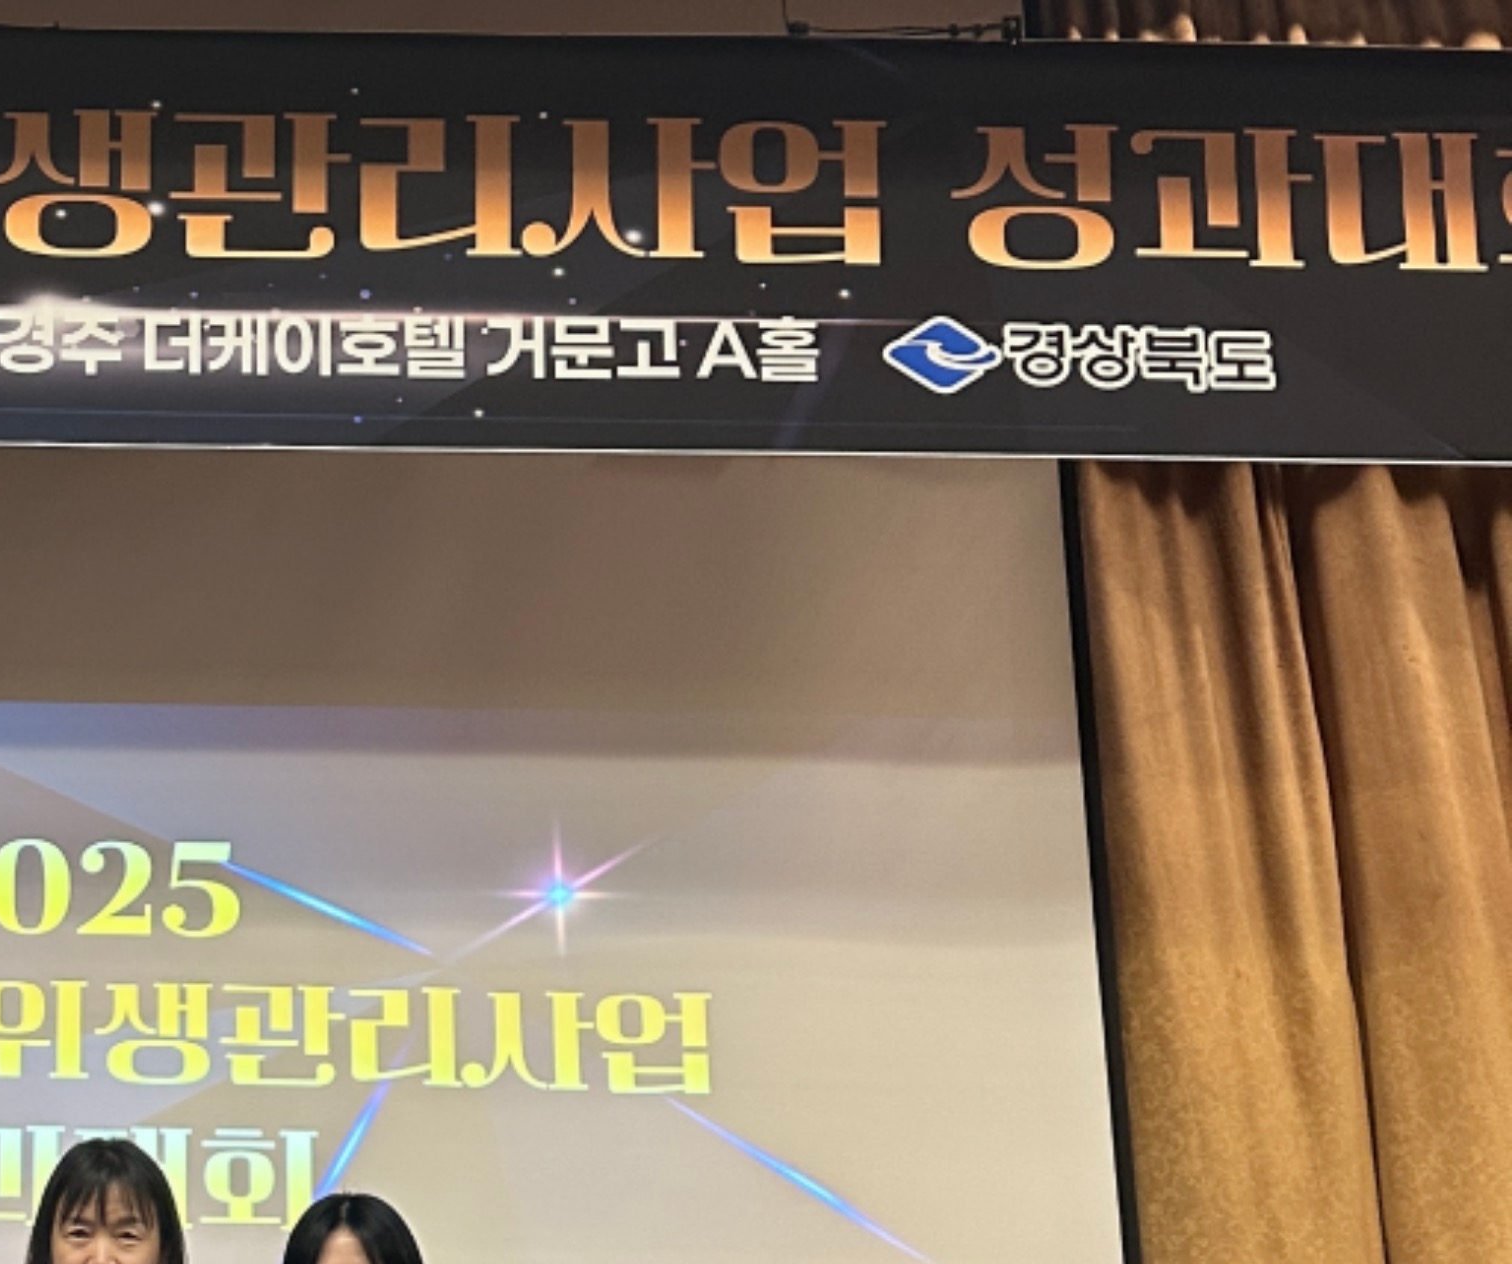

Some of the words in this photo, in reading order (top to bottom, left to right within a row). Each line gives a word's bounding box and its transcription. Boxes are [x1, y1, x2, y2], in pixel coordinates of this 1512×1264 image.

[950, 122, 1512, 272] 성과대
[142, 313, 467, 380] 더케이호텔
[483, 315, 682, 380] 거문고
[696, 316, 822, 384] A홀
[1002, 322, 1278, 393] 경상북도
